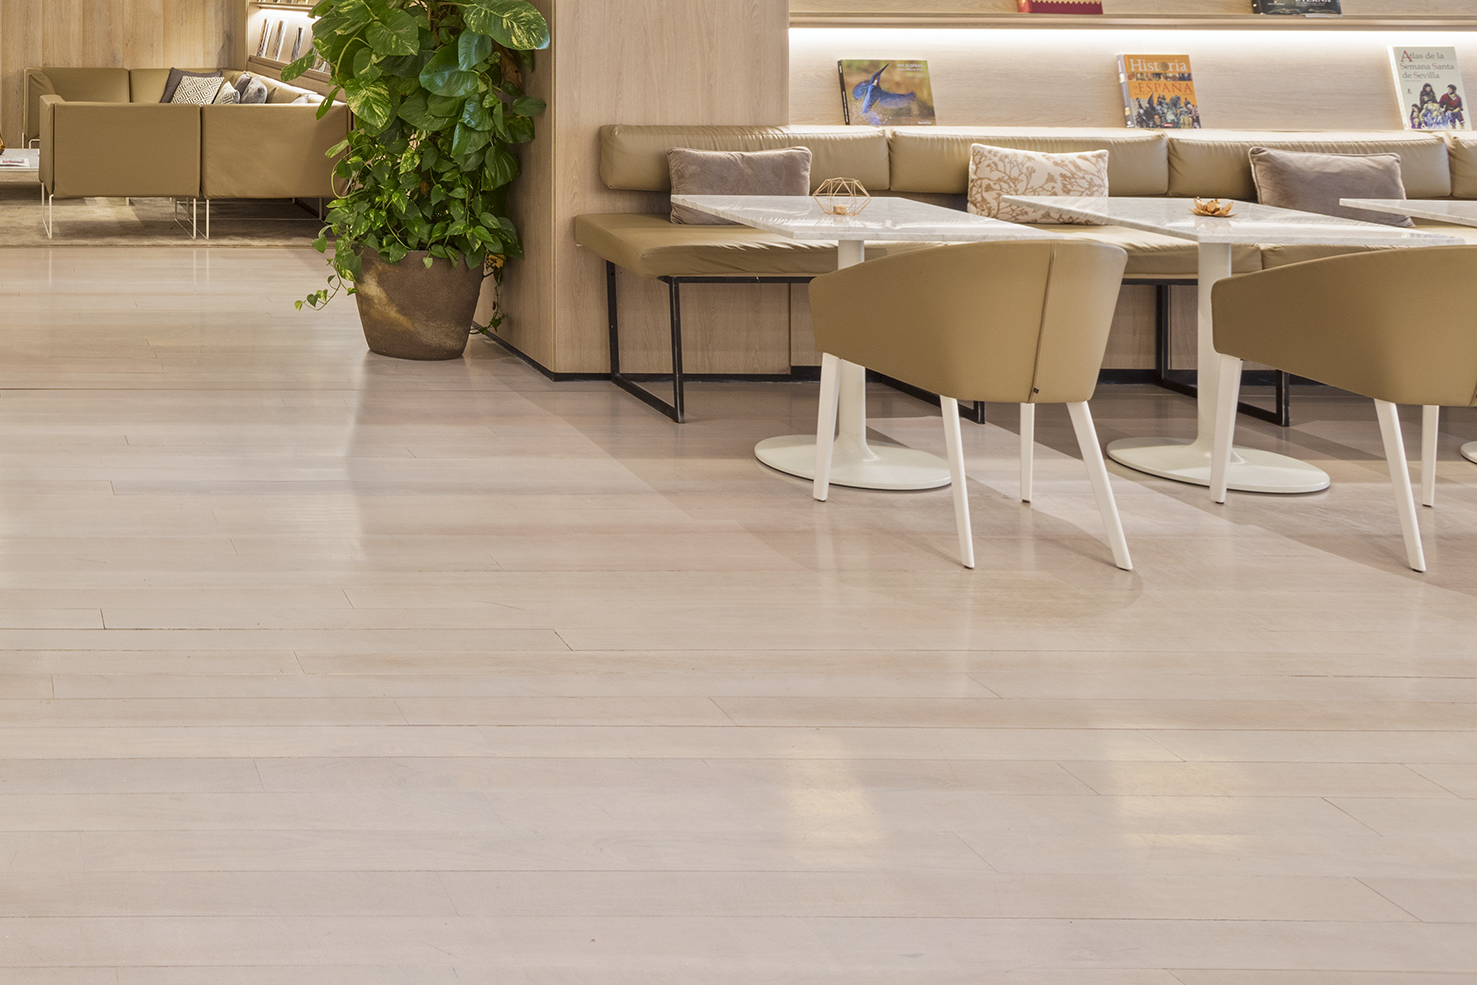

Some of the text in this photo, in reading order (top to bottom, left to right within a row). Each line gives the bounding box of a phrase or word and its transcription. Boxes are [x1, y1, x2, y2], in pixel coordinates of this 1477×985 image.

[1400, 50, 1444, 63] Atlas de la
[1399, 62, 1455, 70] Semana Santa
[1412, 71, 1440, 79] Sevilla
[1137, 81, 1193, 93] ESPAÑA
